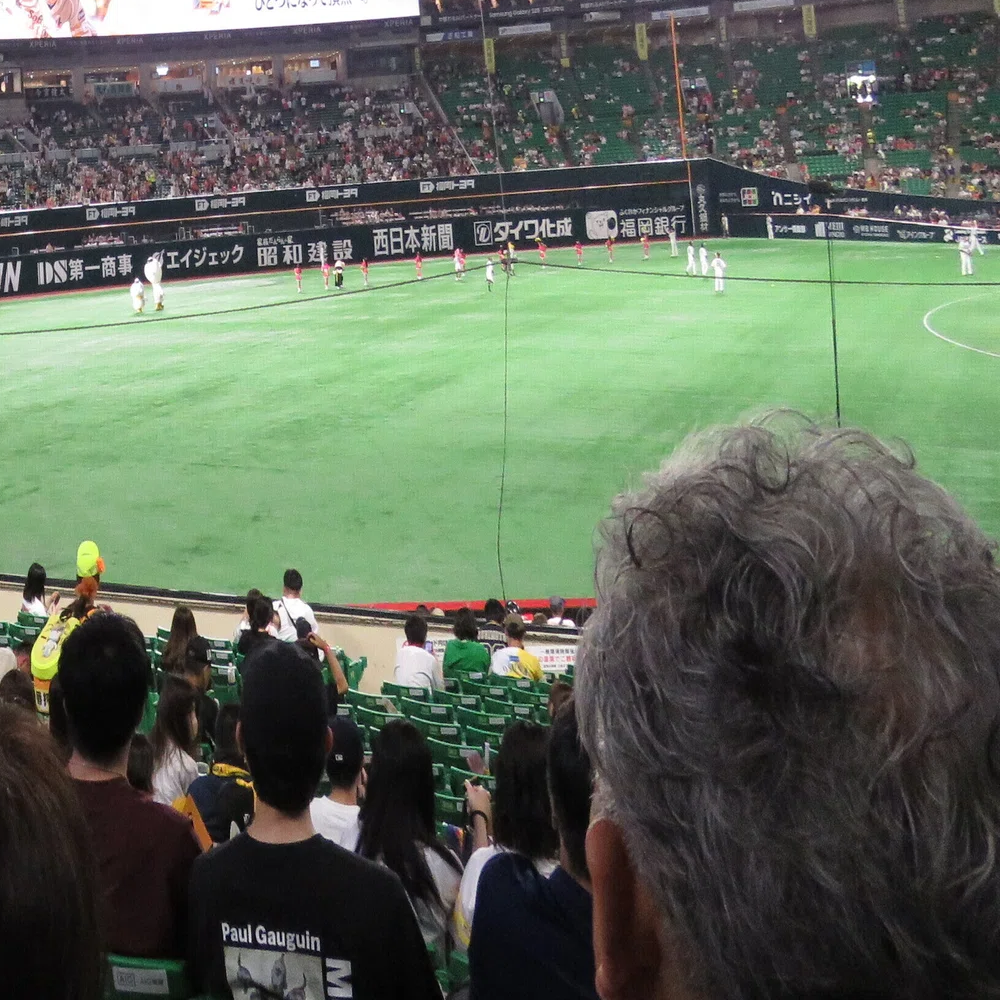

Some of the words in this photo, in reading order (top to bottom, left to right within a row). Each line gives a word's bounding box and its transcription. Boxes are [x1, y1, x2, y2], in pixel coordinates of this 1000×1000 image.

[29, 39, 57, 48] XPERIA
[203, 32, 231, 40] XPERIA
[373, 223, 454, 257] 西日本新聞
[494, 217, 573, 242] ダイワ化成
[619, 215, 687, 238] 福岡銀行
[166, 243, 244, 270] エイジェック
[257, 239, 353, 267] 昭和建設
[68, 253, 133, 281] 第一商事
[221, 922, 252, 943] Paul
[255, 924, 321, 952] Gauguin
